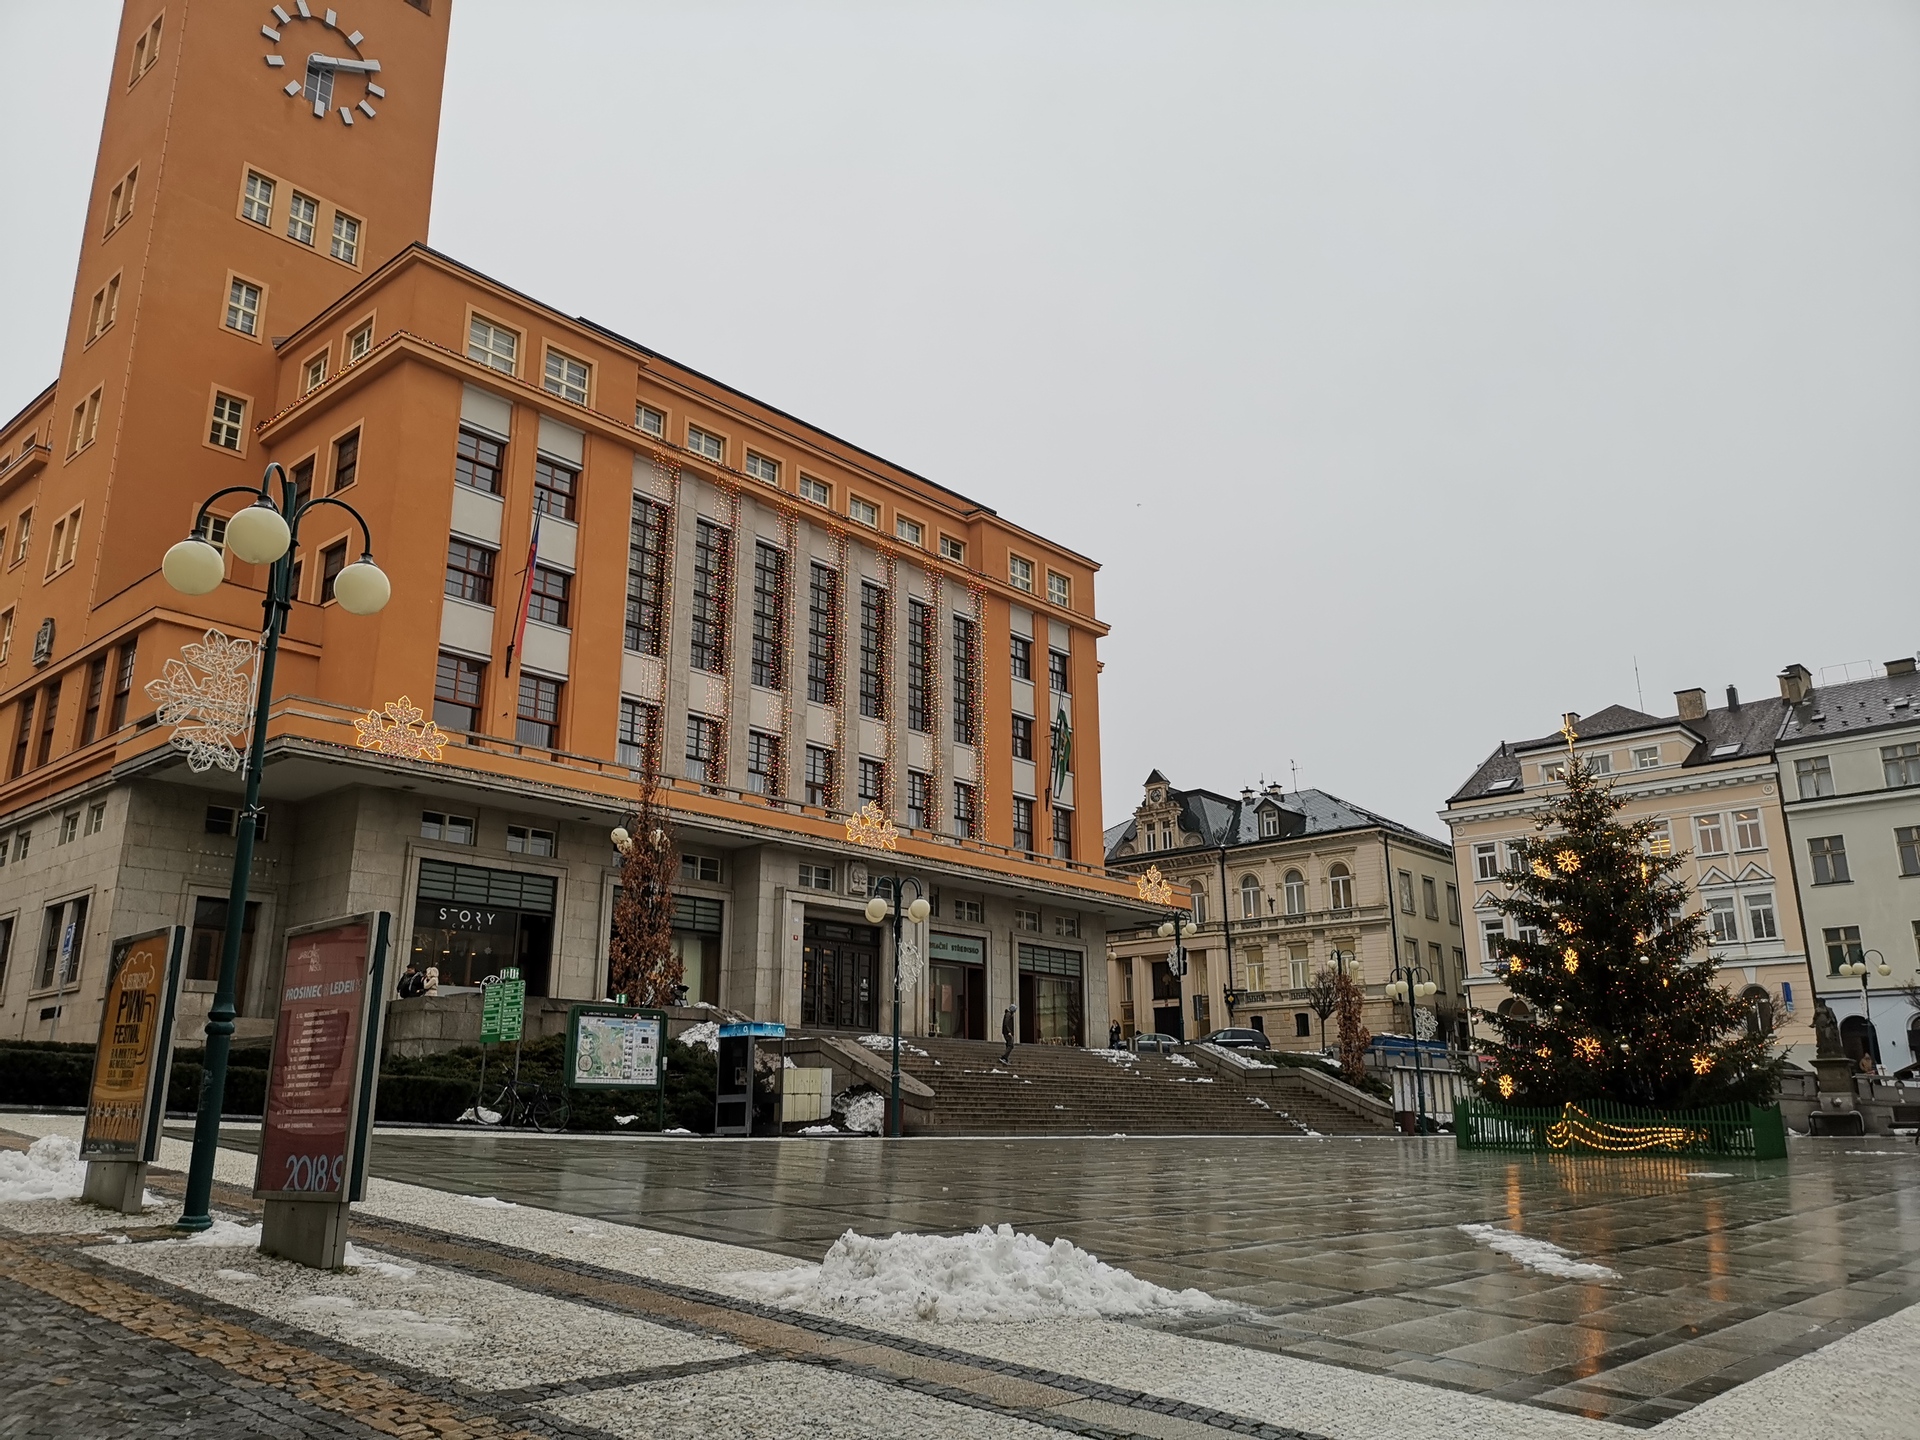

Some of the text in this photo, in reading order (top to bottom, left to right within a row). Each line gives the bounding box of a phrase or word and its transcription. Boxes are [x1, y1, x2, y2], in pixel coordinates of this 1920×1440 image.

[439, 907, 496, 925] STORY
[285, 984, 323, 1001] PROSINEC
[330, 979, 356, 996] LEDEN
[113, 1024, 140, 1044] FESTIVAL
